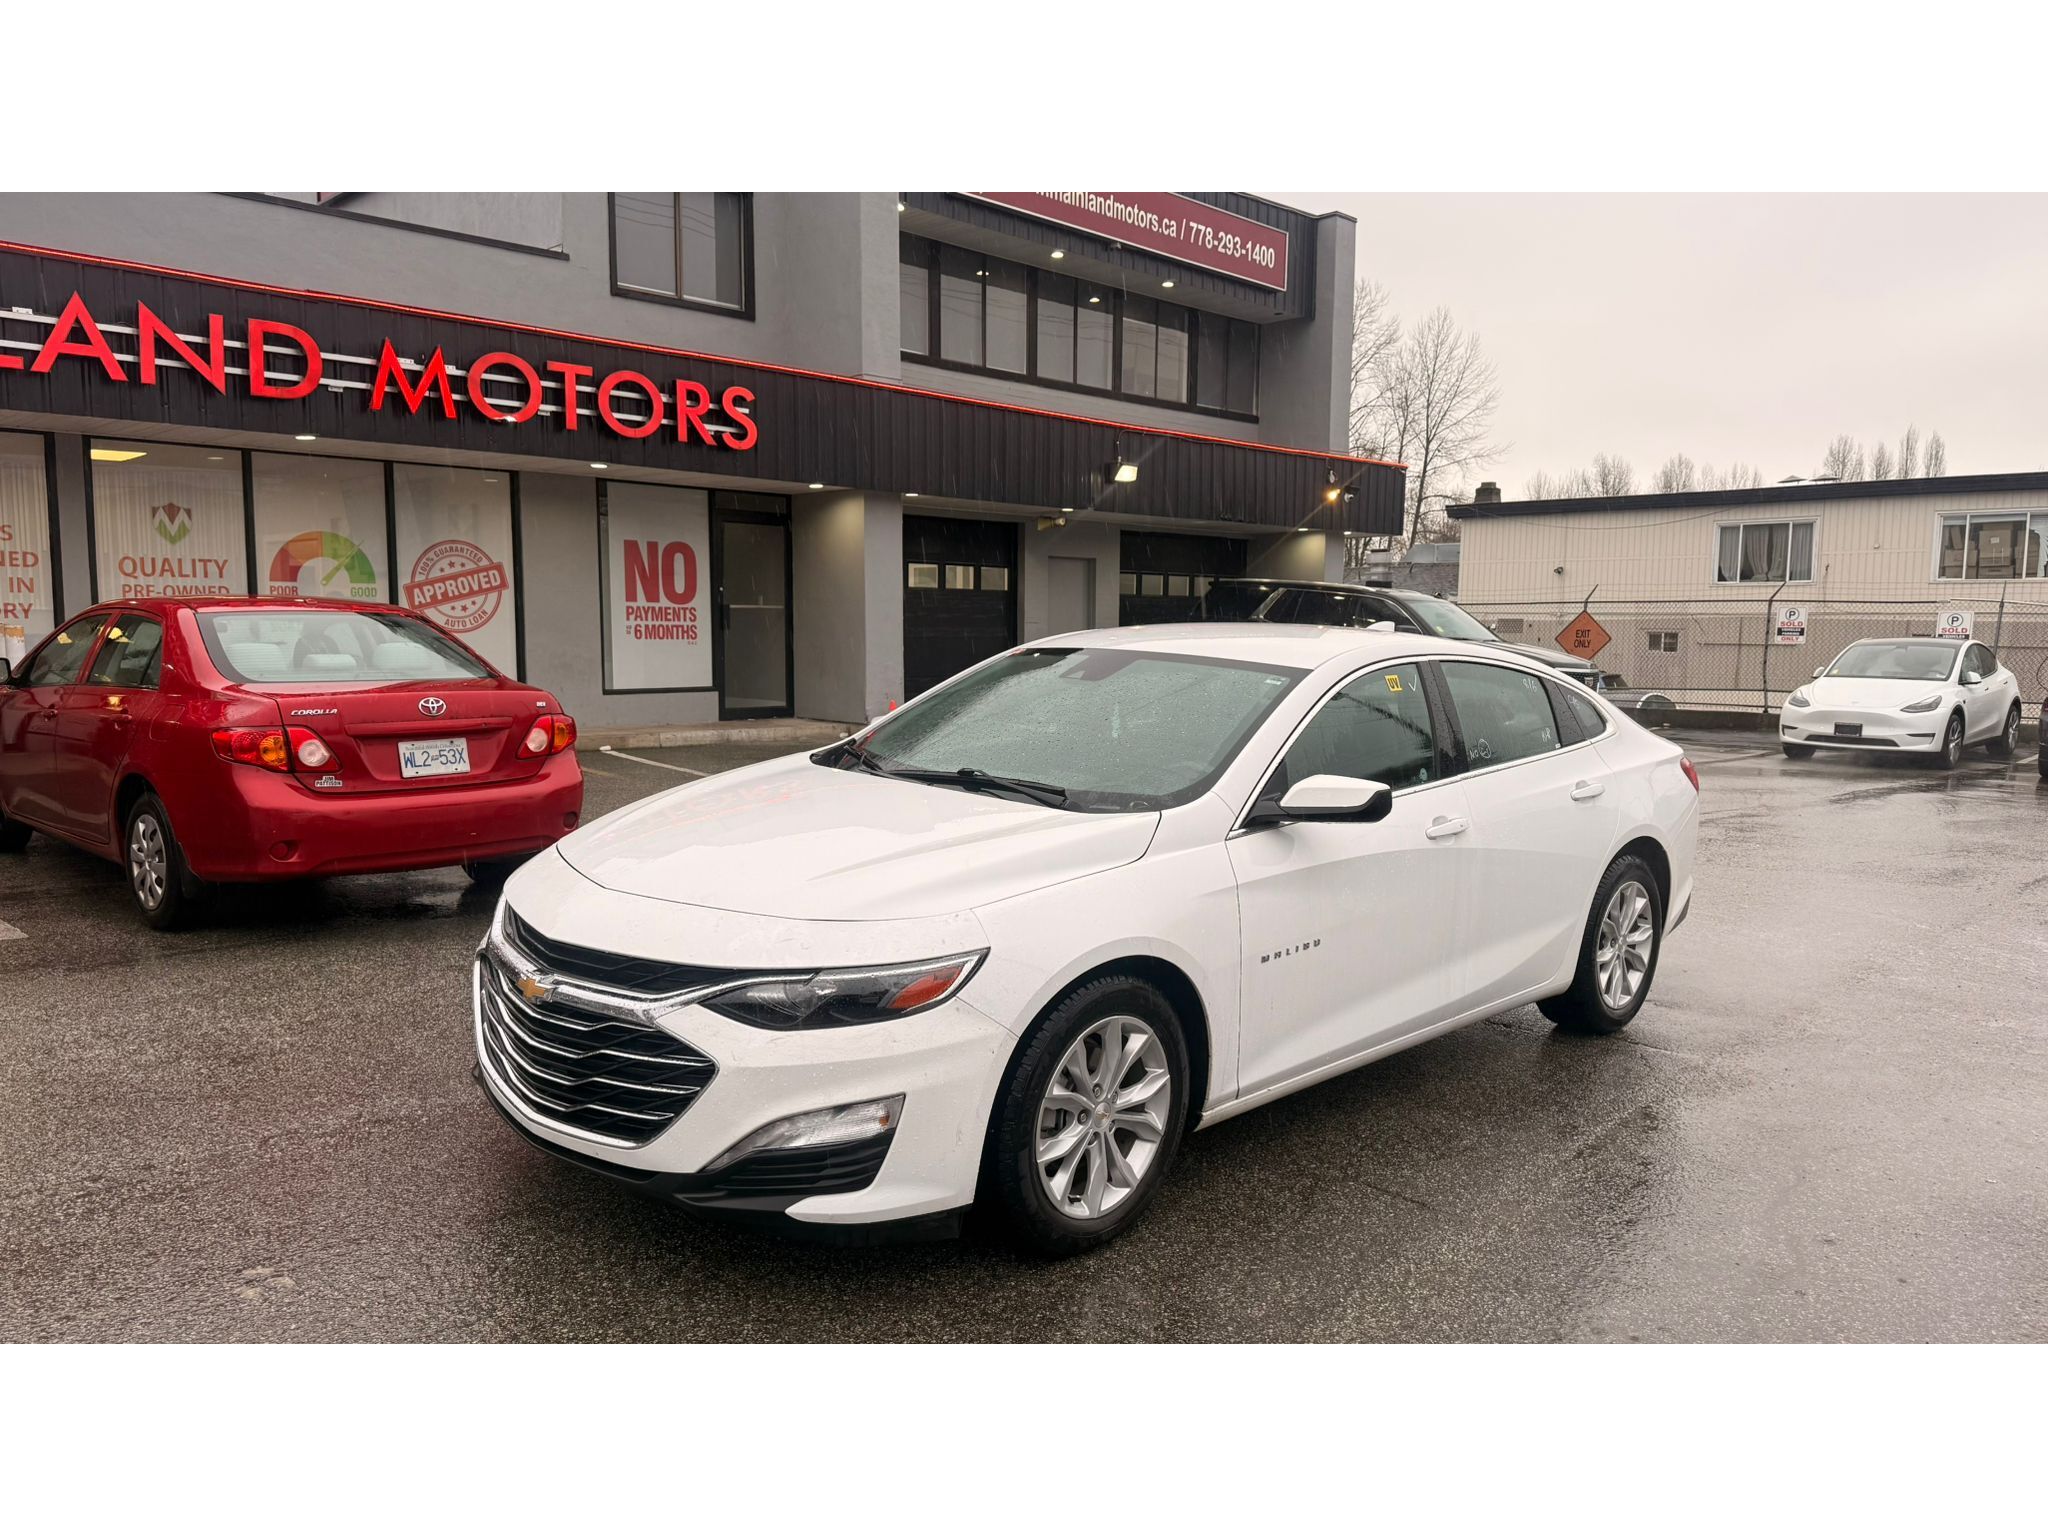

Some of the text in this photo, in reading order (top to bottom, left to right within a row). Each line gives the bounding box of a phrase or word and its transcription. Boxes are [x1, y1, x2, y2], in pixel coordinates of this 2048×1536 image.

[1189, 221, 1275, 269] 778-293-1400
[0, 290, 758, 451] AND MOTORS
[0, 551, 39, 568] ED
[118, 556, 229, 579] QUALITY
[419, 545, 483, 576] 100% GUARANTEED
[624, 539, 697, 605] NO
[9, 576, 35, 593] IN
[121, 583, 230, 598] PRE-OWNED
[269, 585, 299, 596] POOR
[350, 586, 378, 598] GOOD
[413, 569, 501, 606] APPROVED
[444, 608, 488, 628] AUTO LOAN
[626, 606, 697, 622] PAYMENTS
[634, 623, 643, 640] 6
[644, 624, 698, 640] MONTHS
[1575, 629, 1592, 638] EXIT
[1573, 639, 1592, 648] ONLY
[1387, 677, 1400, 689] UV
[291, 708, 338, 716] COROLLA
[1261, 938, 1321, 964] MALIBU
